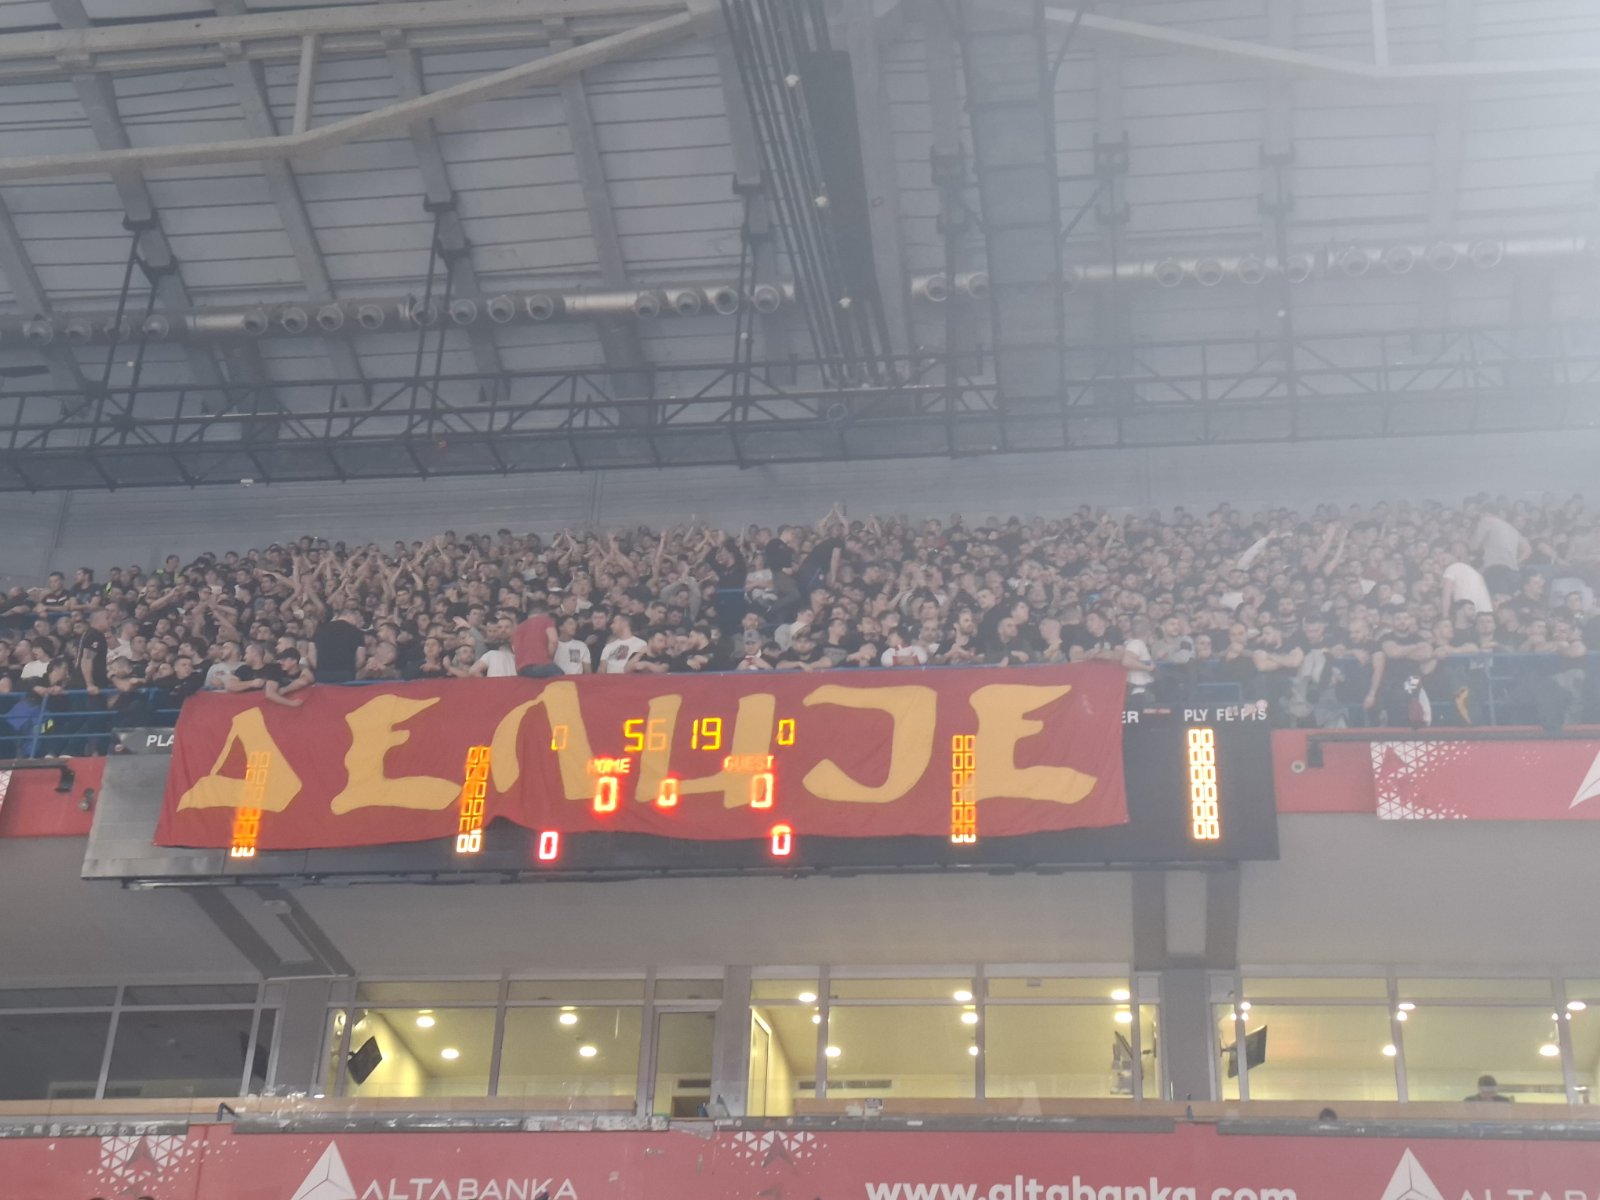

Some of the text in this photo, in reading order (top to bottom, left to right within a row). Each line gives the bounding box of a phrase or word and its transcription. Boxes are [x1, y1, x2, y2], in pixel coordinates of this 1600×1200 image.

[1184, 709, 1208, 722] PLY
[691, 717, 723, 750] 19
[777, 718, 796, 746] 0
[1188, 728, 1214, 747] 00
[587, 757, 631, 774] HOME
[723, 754, 775, 771] GUEST
[1189, 747, 1215, 766] 00
[1190, 765, 1216, 784] 00
[593, 775, 619, 812] 0
[657, 778, 679, 807] 0
[750, 773, 774, 808] 0
[1191, 783, 1217, 802] 00
[1192, 801, 1218, 820] 00
[1193, 820, 1220, 839] 00
[539, 831, 559, 860] 0
[771, 824, 791, 856] 0
[361, 1178, 578, 1200] ALTABANKA
